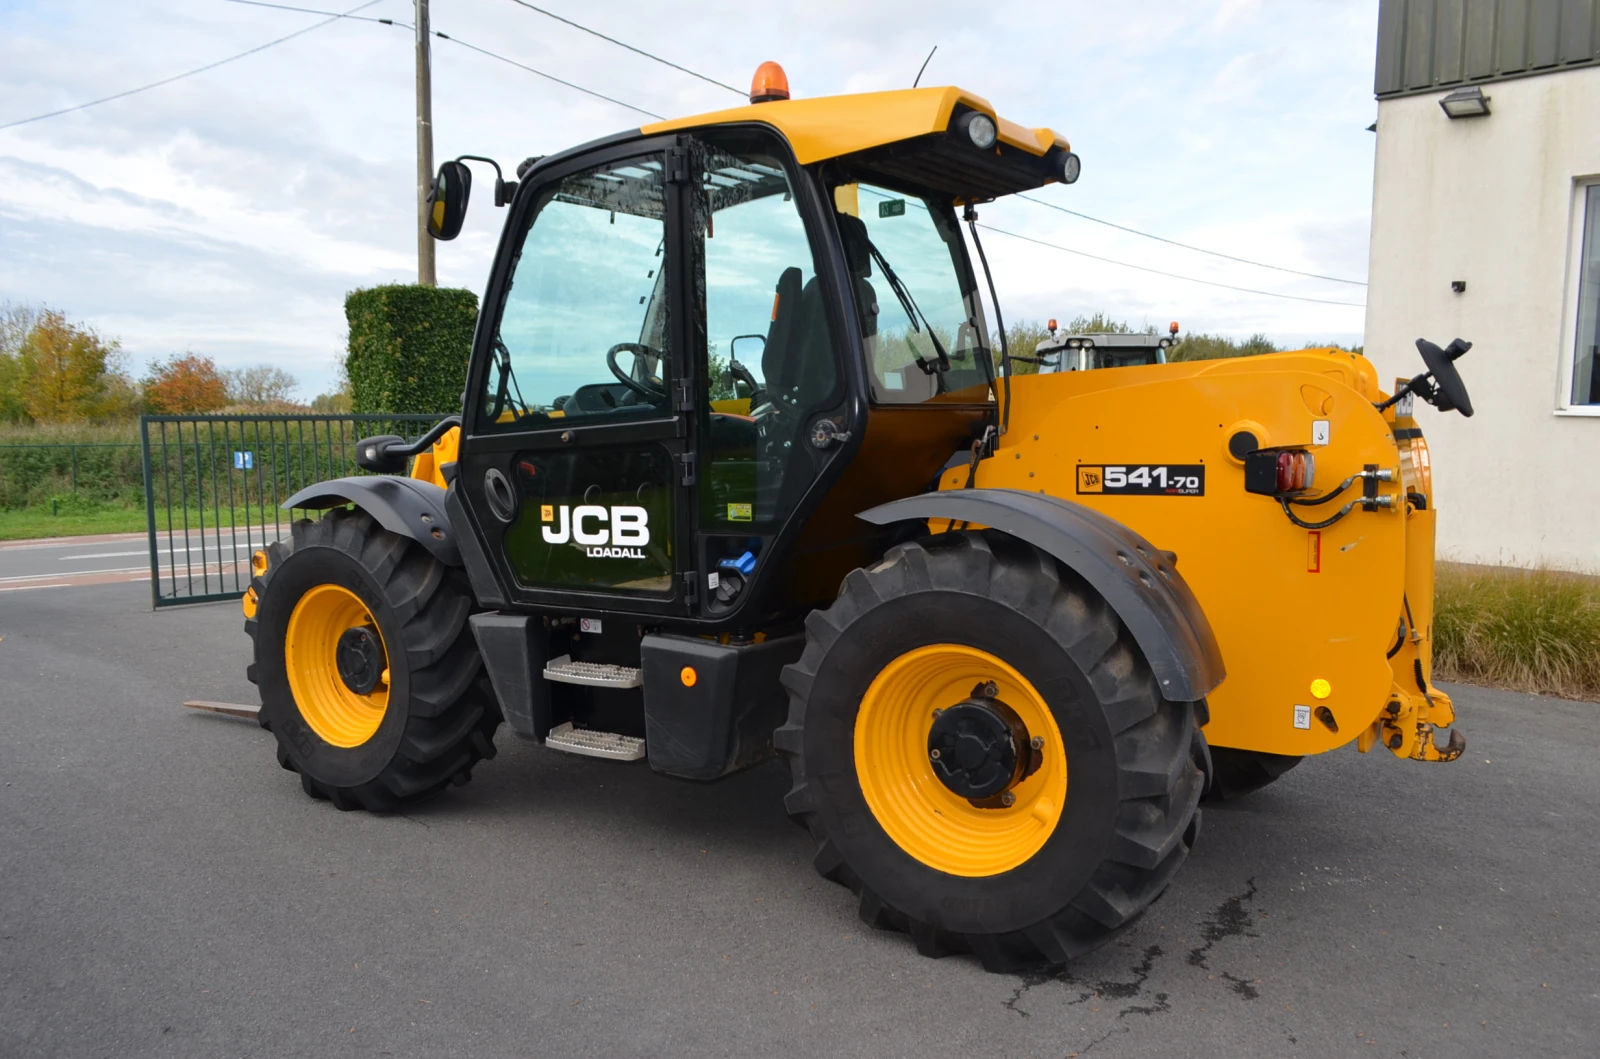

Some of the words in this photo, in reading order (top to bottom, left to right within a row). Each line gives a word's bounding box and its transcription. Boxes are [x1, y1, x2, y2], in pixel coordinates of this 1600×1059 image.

[1085, 473, 1100, 486] JCB
[1104, 466, 1199, 488] 541-70
[541, 505, 650, 546] JCB
[586, 547, 645, 559] LOADALL
